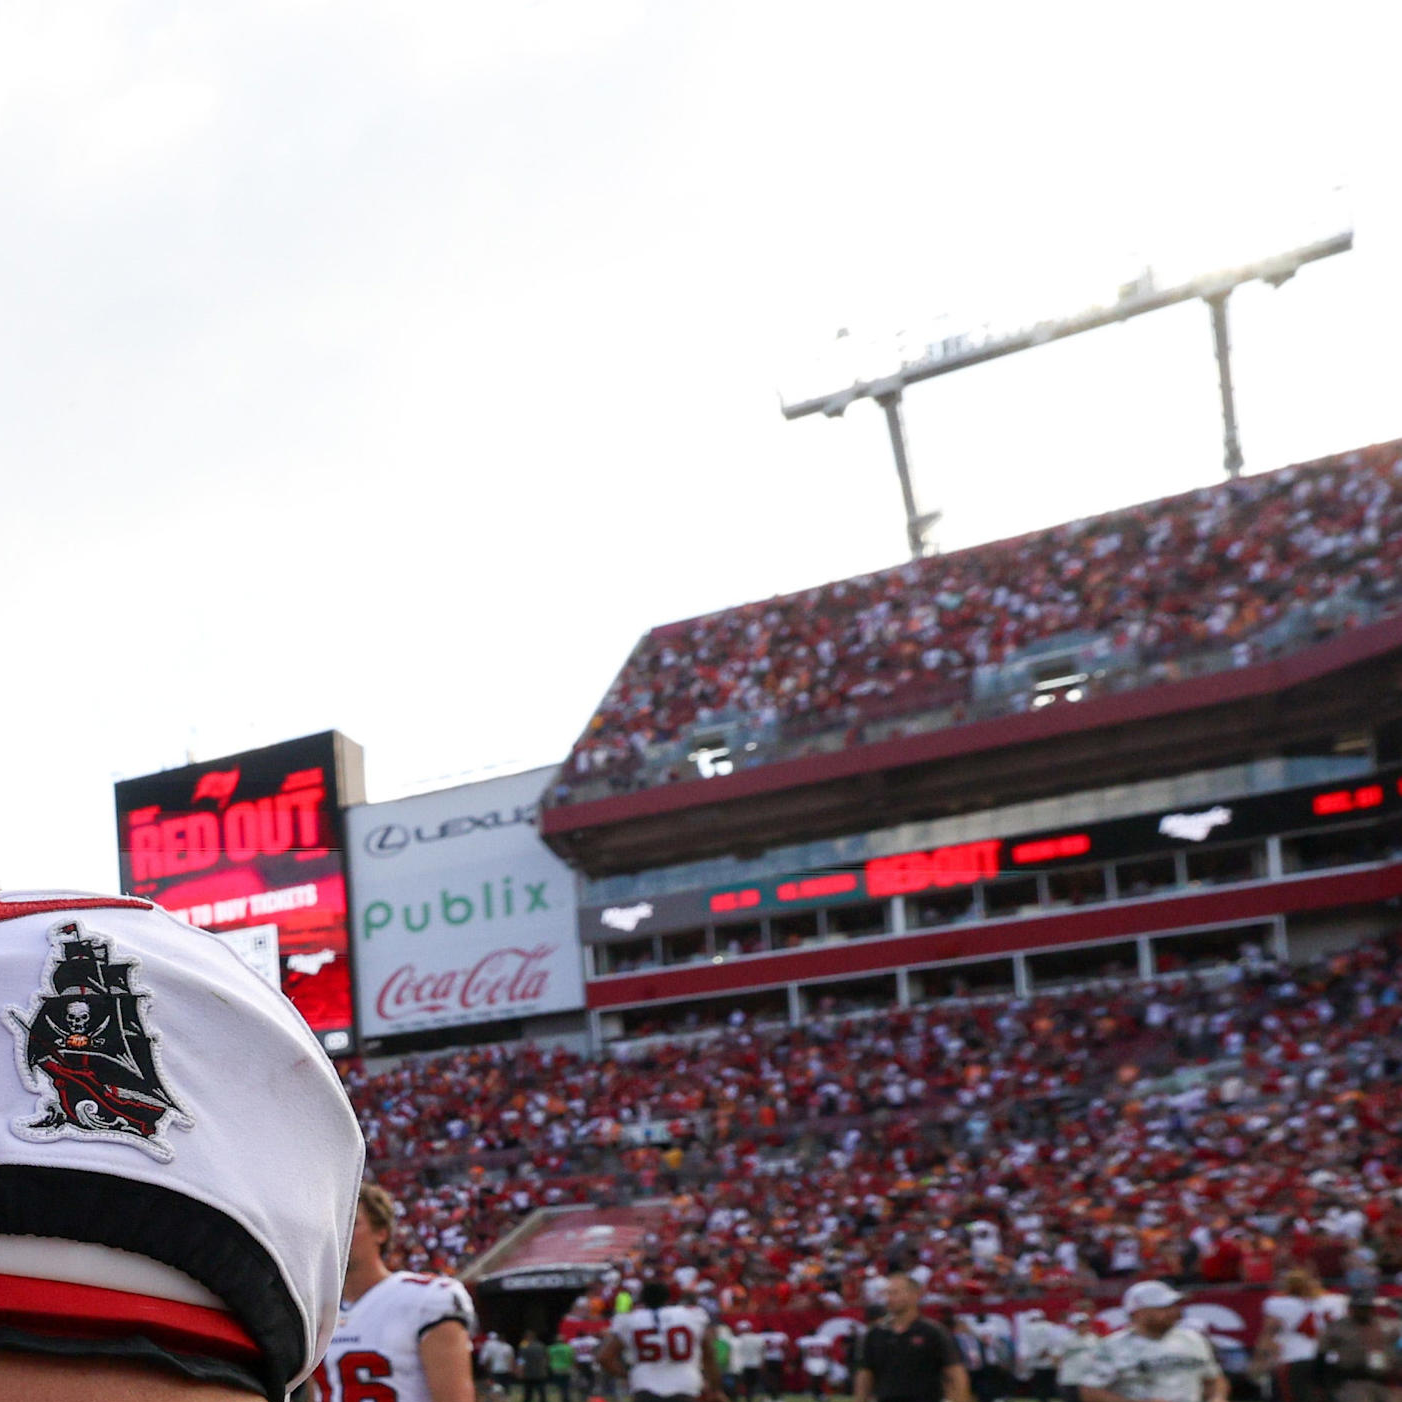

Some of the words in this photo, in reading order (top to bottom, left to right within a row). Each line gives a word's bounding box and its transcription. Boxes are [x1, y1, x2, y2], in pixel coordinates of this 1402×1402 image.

[129, 808, 222, 883] RED
[223, 784, 327, 865] OUT
[362, 875, 550, 940] Publix
[633, 1325, 694, 1363] 50
